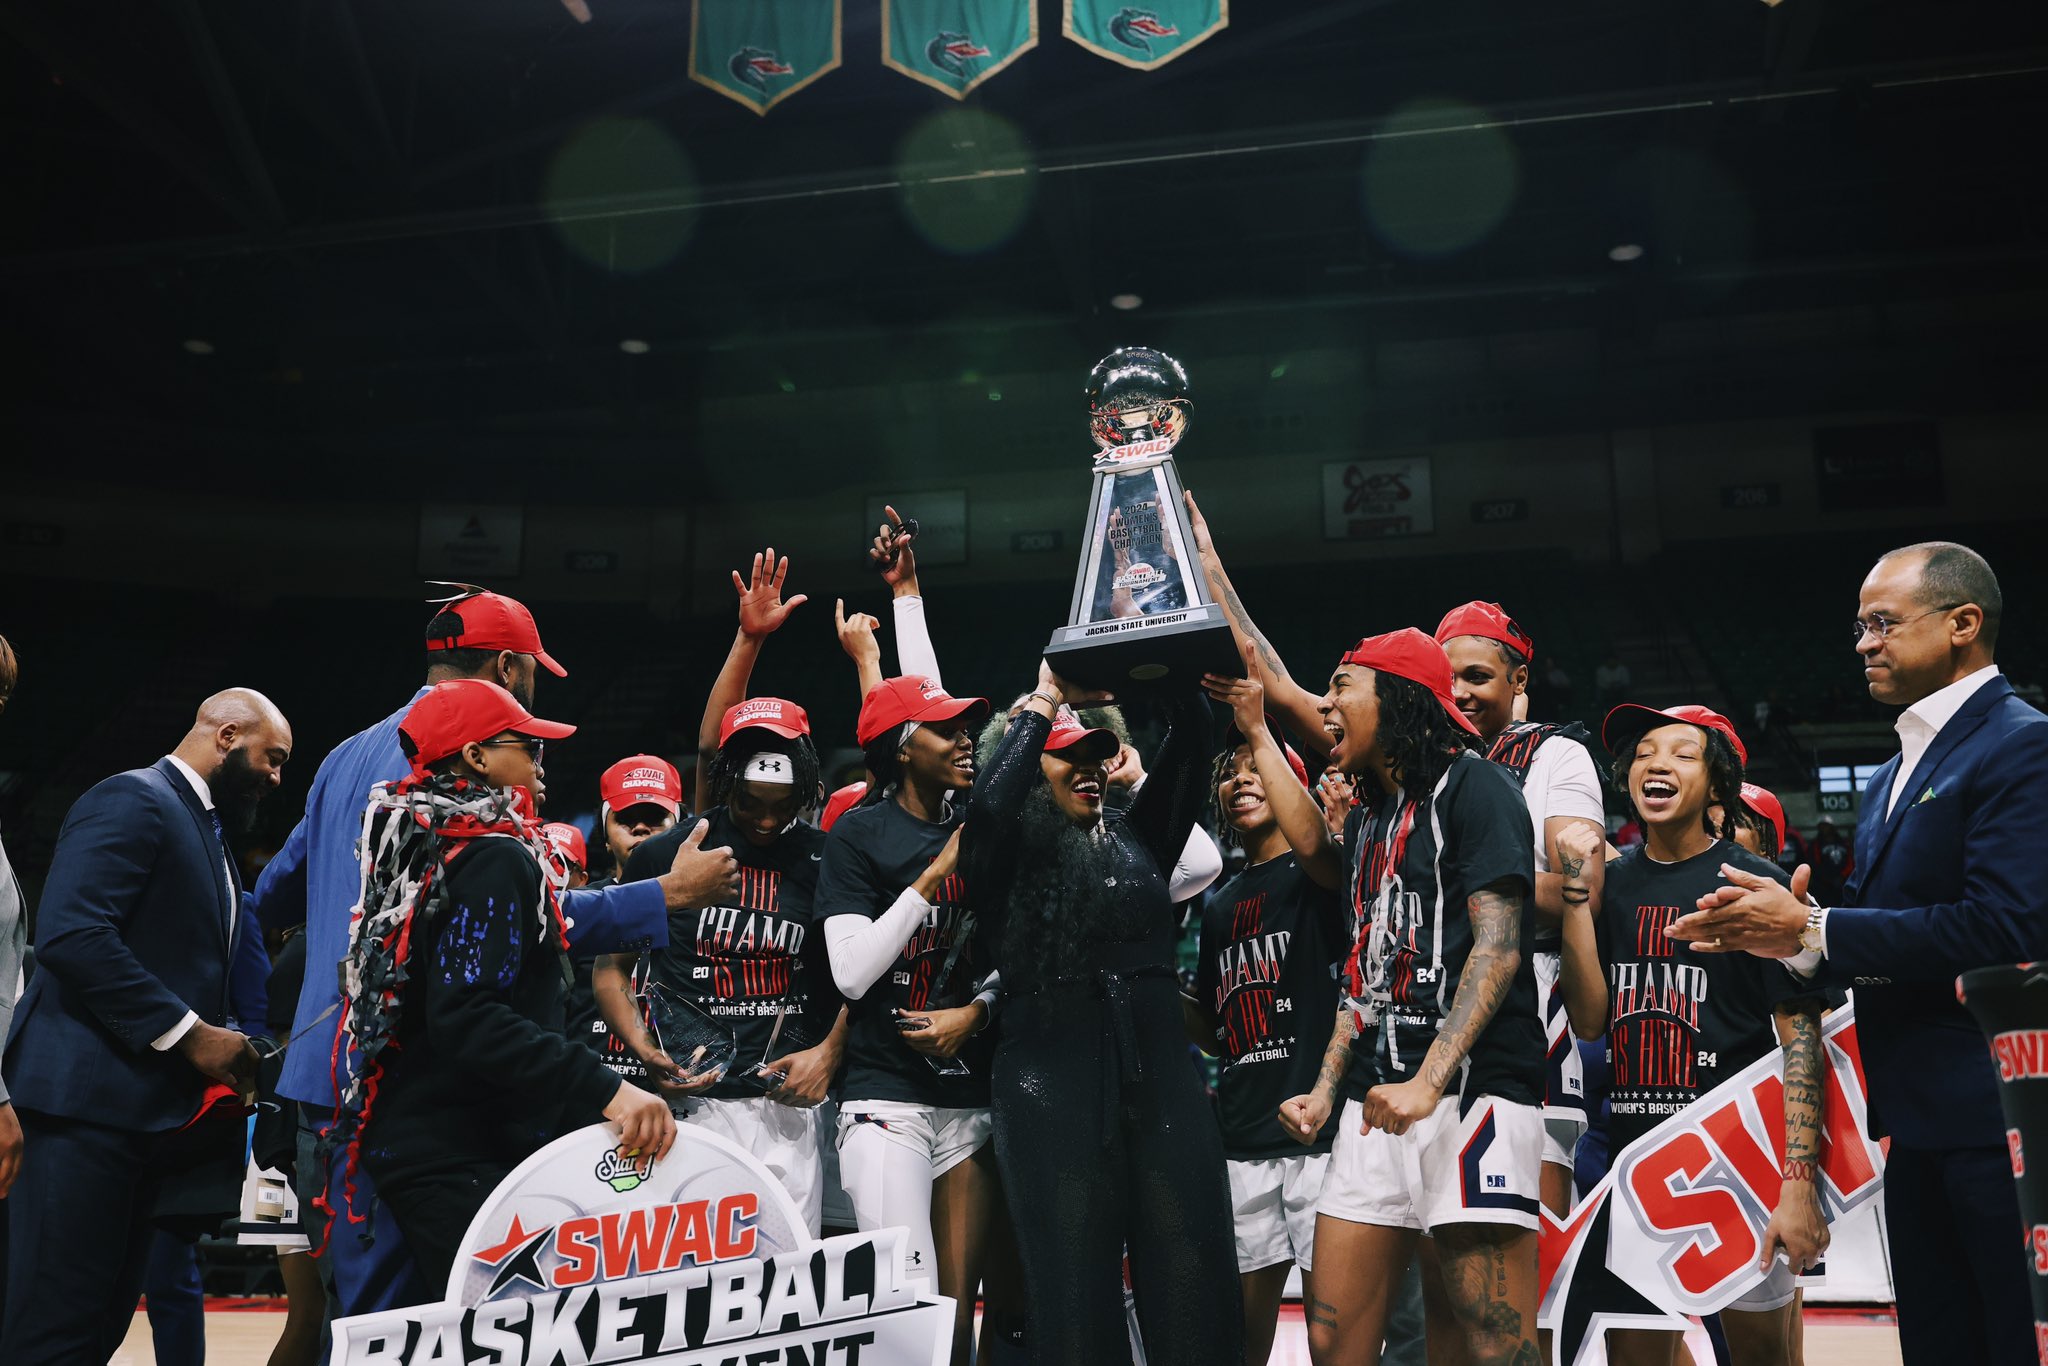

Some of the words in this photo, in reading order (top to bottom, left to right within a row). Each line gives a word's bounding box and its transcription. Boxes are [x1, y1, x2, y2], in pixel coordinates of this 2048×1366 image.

[1114, 440, 1168, 459] SWAC
[1125, 502, 1148, 515] 2024
[1481, 503, 1516, 520] 207
[1115, 512, 1158, 528] WOMEN'S
[1110, 522, 1164, 539] BASKETBALL
[1114, 533, 1161, 550] CHAMPION
[1118, 576, 1160, 588] TOURNAMENT
[1085, 624, 1119, 637] JACKSON
[1121, 620, 1143, 631] STATE
[1145, 613, 1188, 627] UNIVERSITY
[743, 702, 781, 715] SWAC
[633, 768, 665, 782] SWAC
[1822, 795, 1849, 810] 105
[740, 866, 781, 913] THE
[696, 906, 805, 957] CHAMP
[1636, 905, 1680, 957] THE
[692, 966, 710, 979] 20
[893, 971, 911, 986] 20
[1416, 967, 1437, 983] 24
[709, 1004, 755, 1016] WOMEN'S
[1275, 997, 1293, 1013] 24
[1639, 1018, 1697, 1088] HERE
[1697, 1051, 1717, 1068] 24
[1610, 1102, 1646, 1114] WOMEN'S
[552, 1192, 760, 1289] SWAC
[344, 1230, 919, 1366] BASKETBALL
